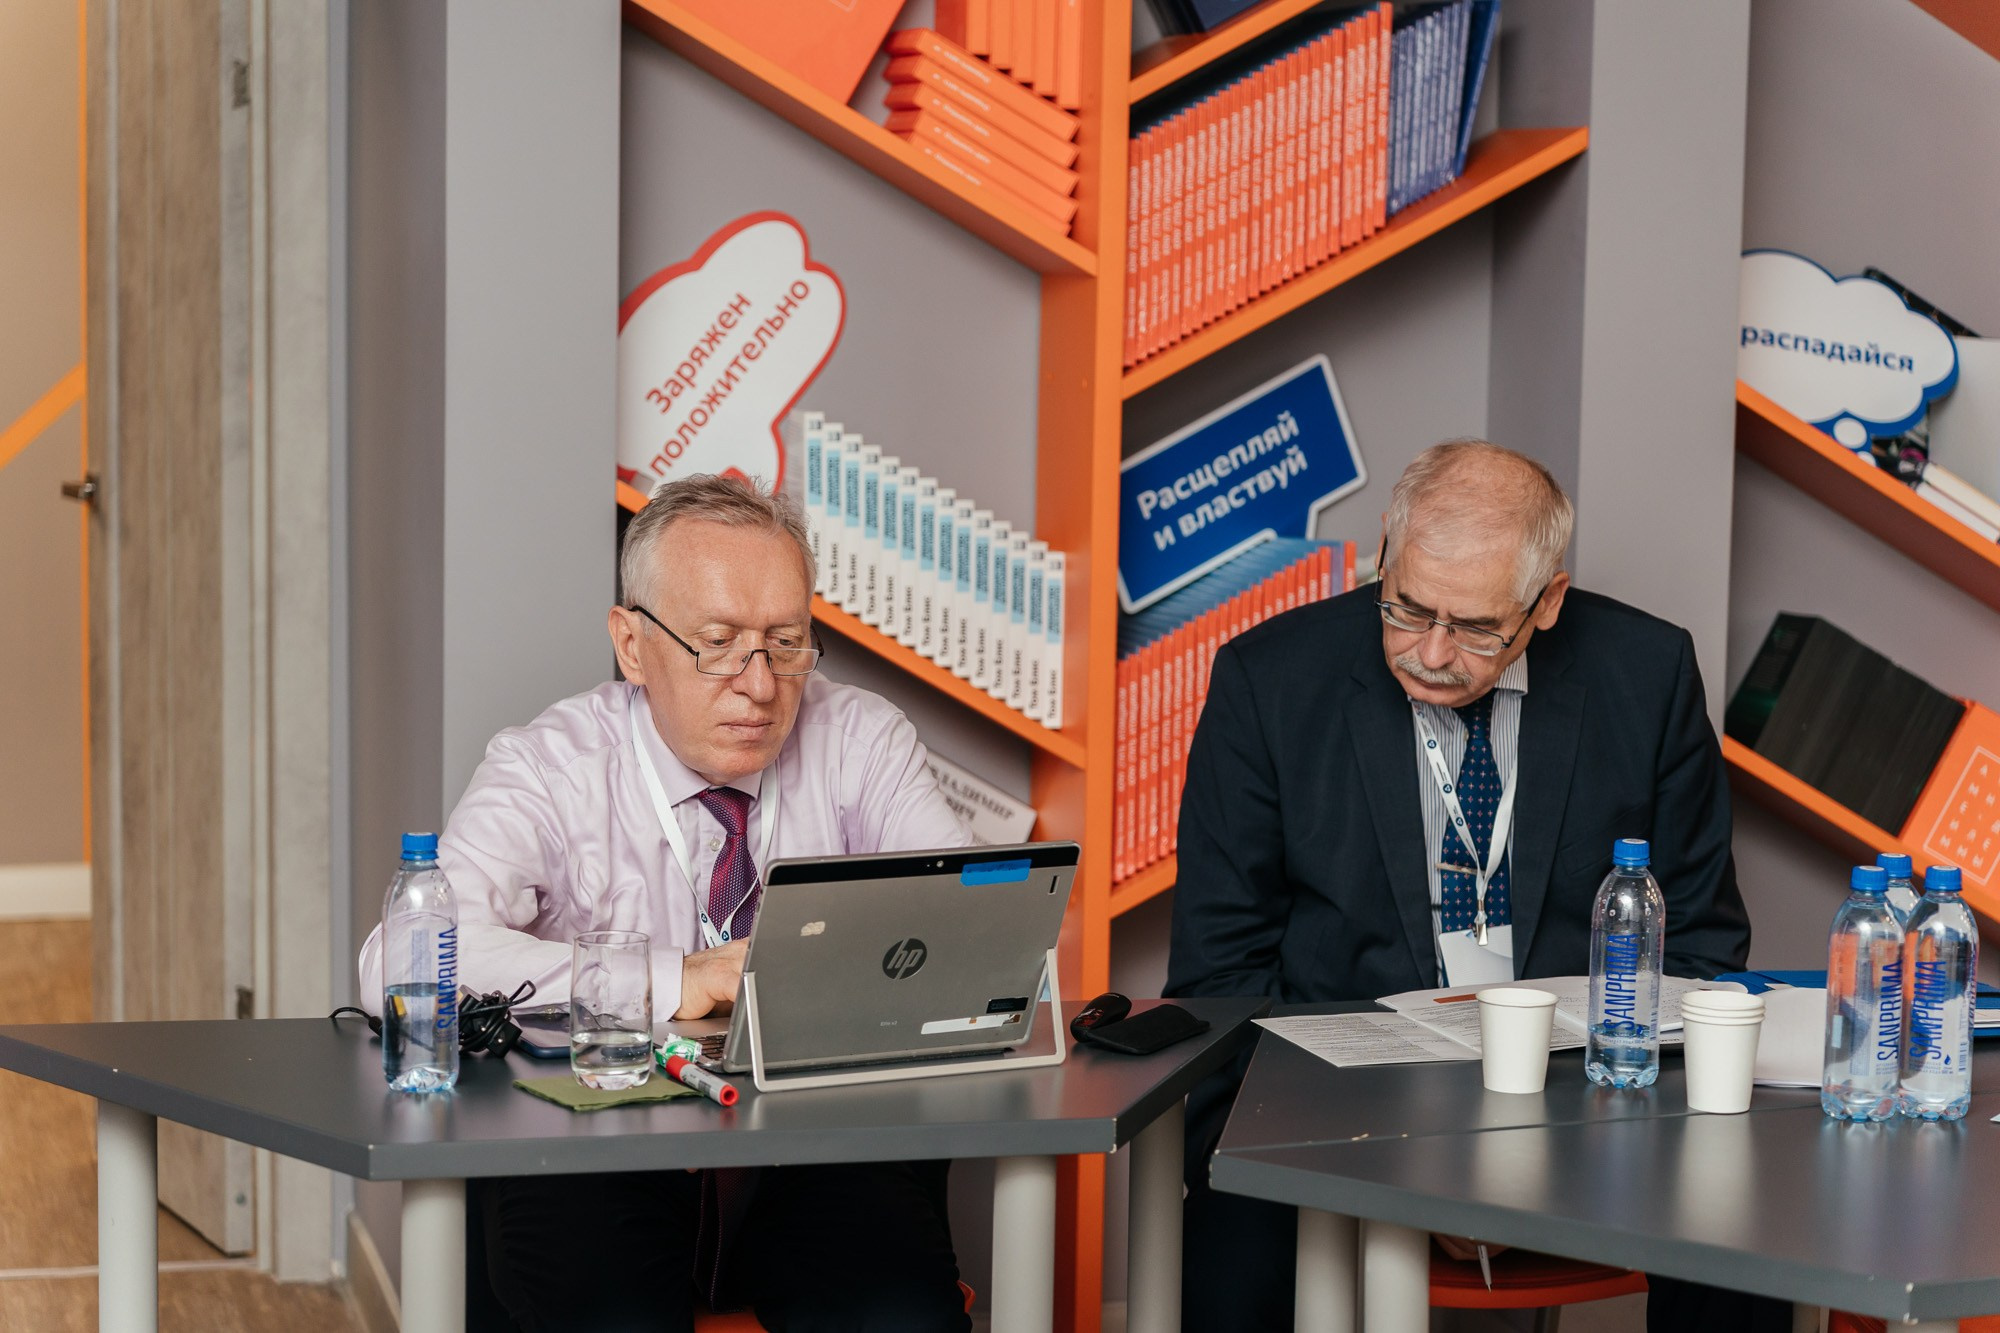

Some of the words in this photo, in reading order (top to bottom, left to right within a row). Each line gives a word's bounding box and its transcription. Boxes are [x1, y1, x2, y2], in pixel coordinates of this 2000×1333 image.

[646, 291, 752, 415] Заряжен
[649, 279, 810, 478] положительно
[1741, 324, 1914, 372] распадайся
[1137, 410, 1300, 520] Расщепляй
[1154, 528, 1176, 551] и
[1177, 445, 1308, 538] властвуй
[437, 926, 458, 1030] SANPRIMA
[885, 938, 925, 980] hp
[1603, 933, 1638, 1032] SANPRIMA
[1909, 960, 1946, 1060] SANPRIMA
[1877, 960, 1903, 1061] SANPRIMA
